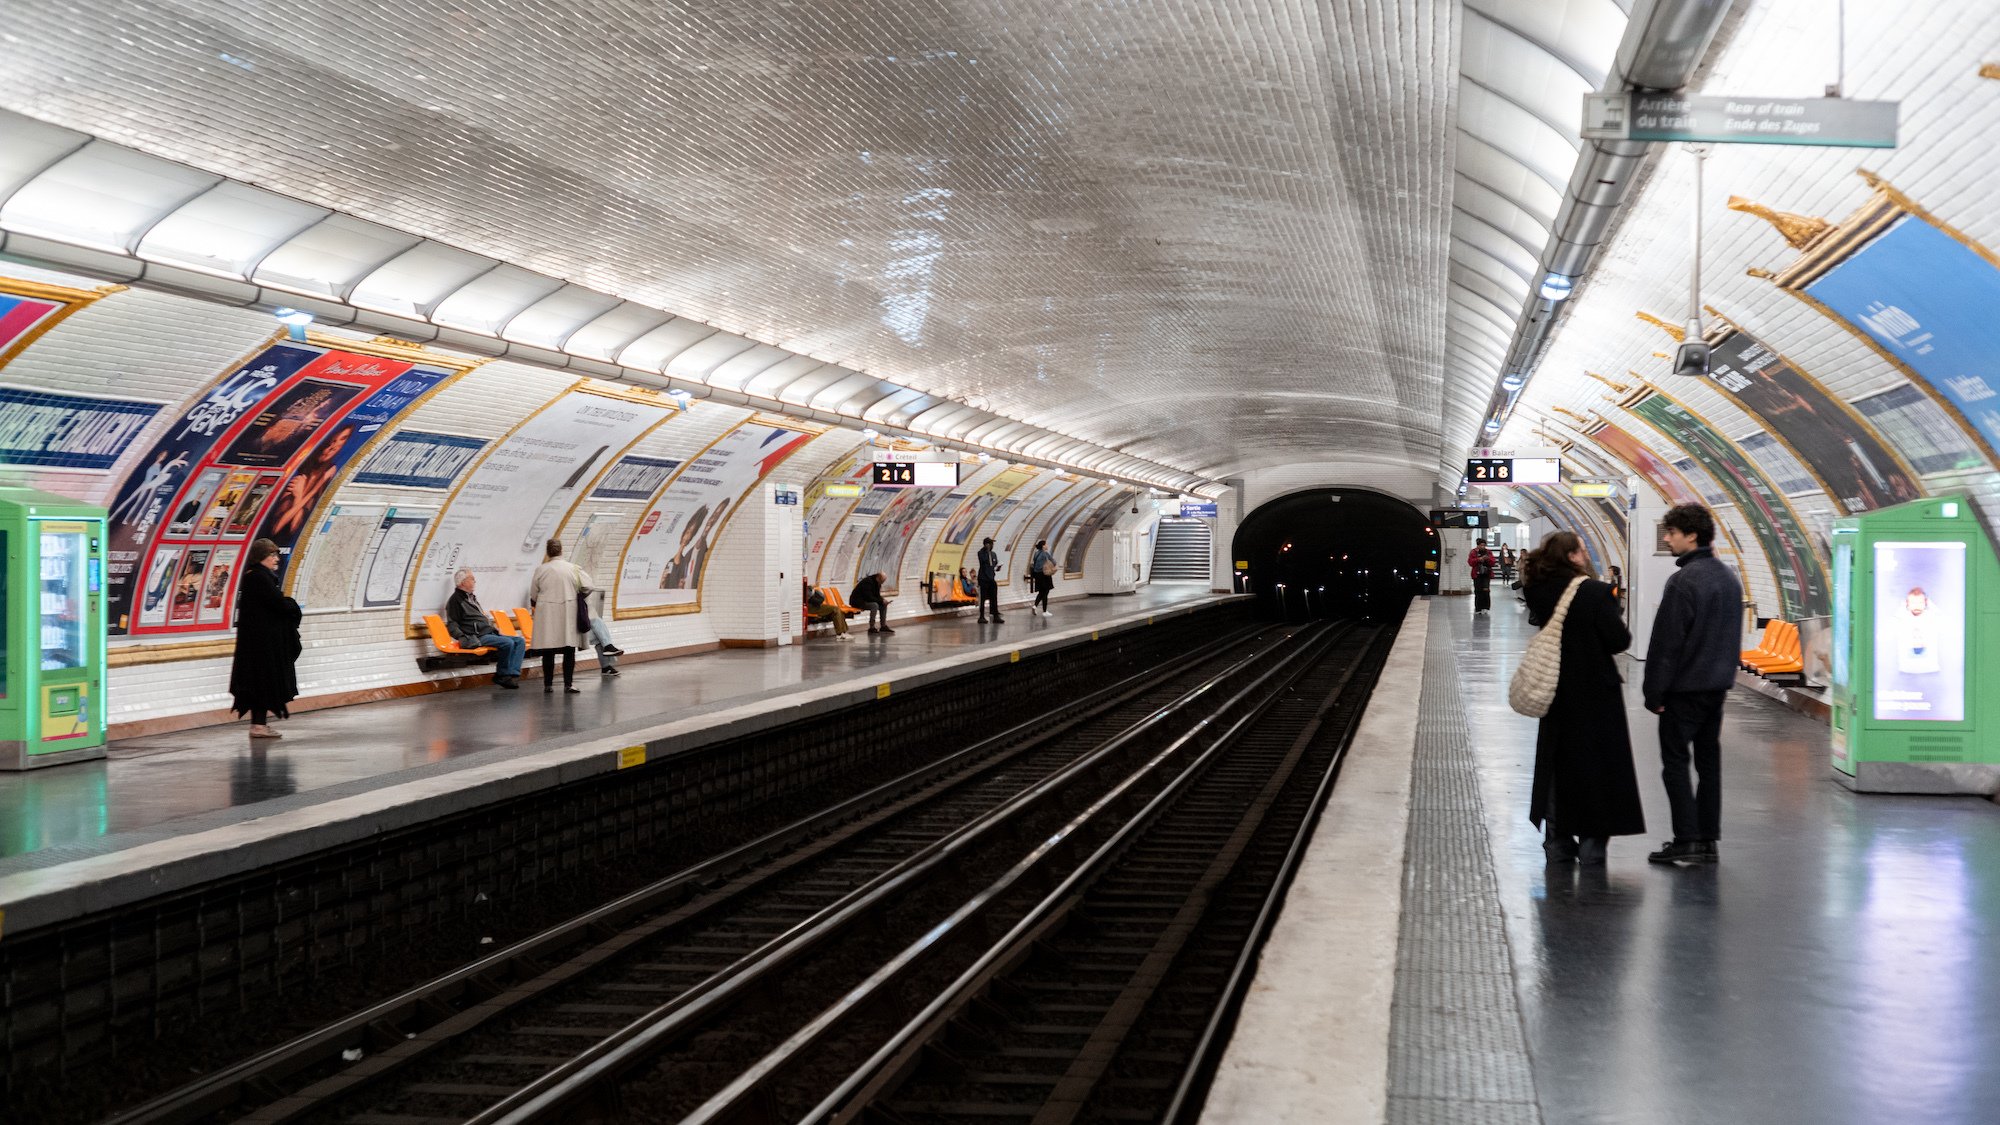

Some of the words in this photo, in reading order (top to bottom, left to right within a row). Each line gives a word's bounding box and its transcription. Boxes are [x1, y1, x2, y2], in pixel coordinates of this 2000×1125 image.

[1638, 98, 1692, 112] Arrière
[1726, 102, 1755, 113] Rear
[1757, 103, 1774, 114] of
[1774, 104, 1805, 116] train
[1638, 114, 1657, 128] du
[1661, 116, 1697, 129] train
[1726, 119, 1757, 130] Ende
[1760, 119, 1781, 130] des
[1784, 120, 1821, 134] Zuges
[206, 370, 277, 411] LAC
[386, 379, 428, 395] LYNDA
[176, 403, 243, 440] CYGNES
[895, 452, 917, 460] Créteil
[882, 470, 890, 480] 2
[901, 469, 910, 481] 4
[1476, 466, 1486, 478] 2
[1498, 466, 1508, 478] 8
